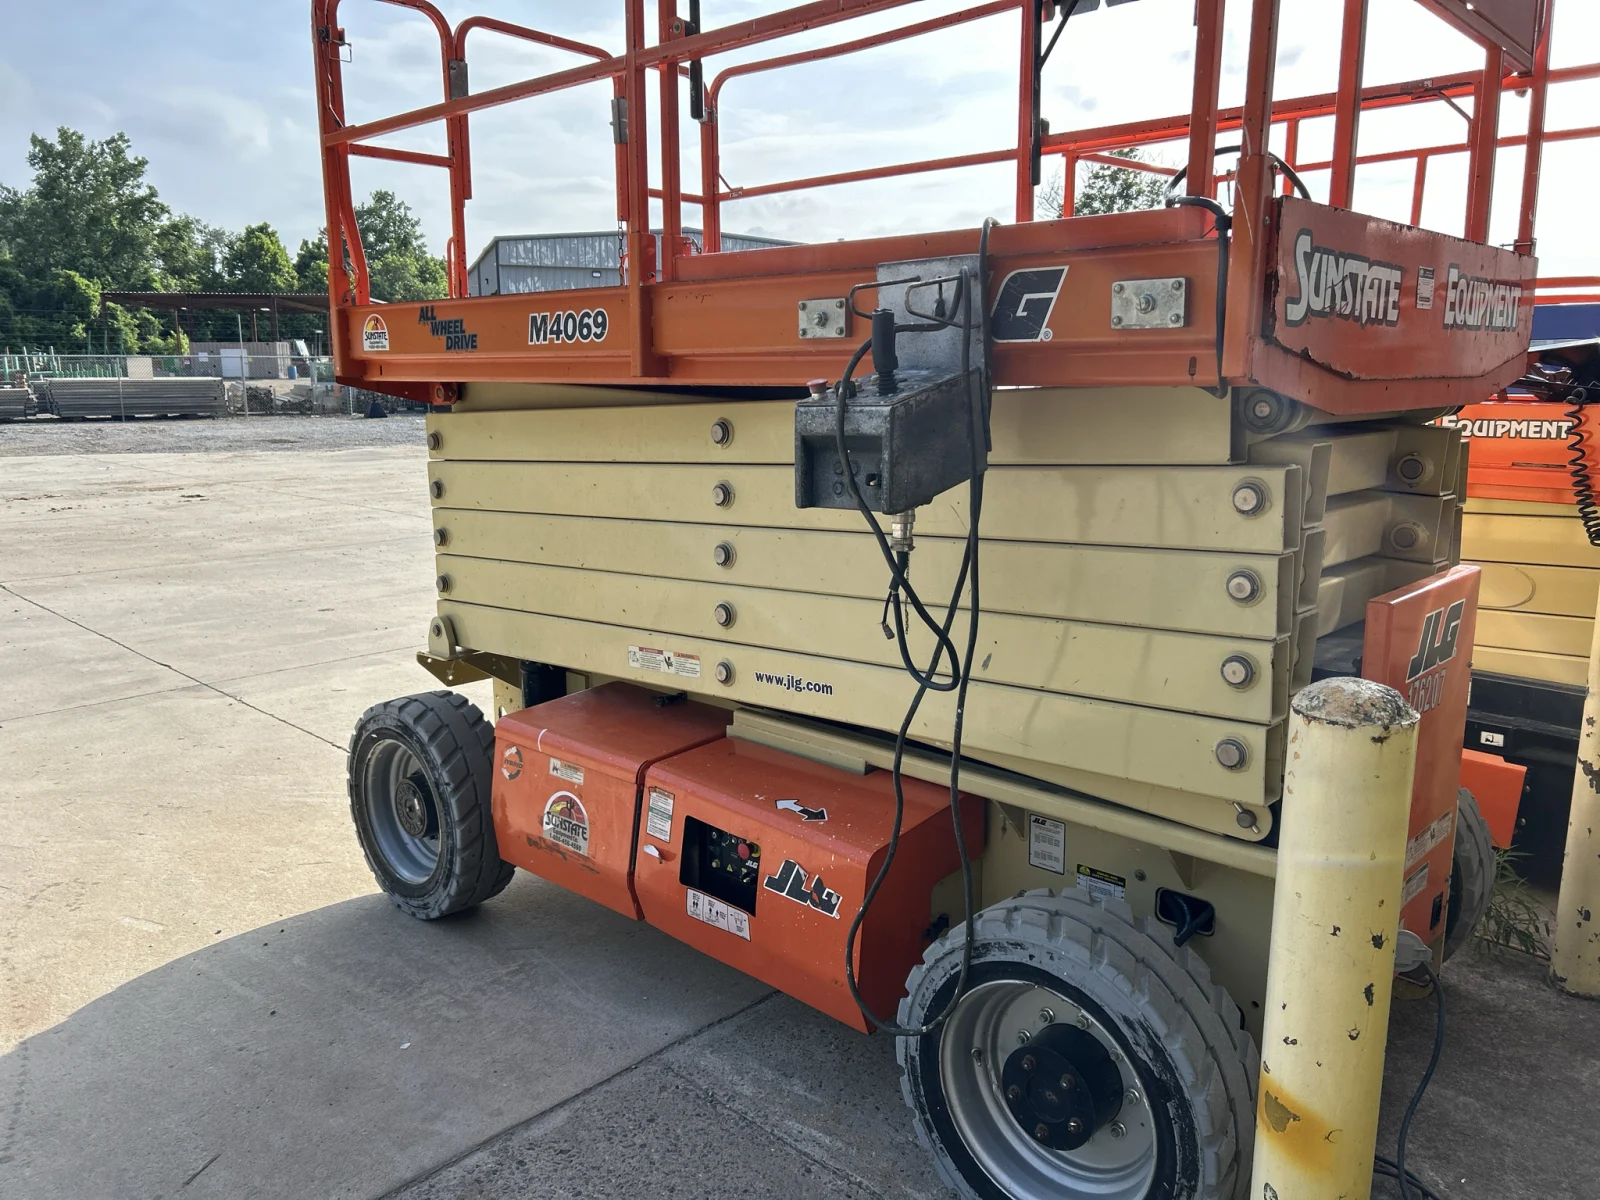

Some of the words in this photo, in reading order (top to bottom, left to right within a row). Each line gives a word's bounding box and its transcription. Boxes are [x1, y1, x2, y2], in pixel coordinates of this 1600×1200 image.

[1285, 228, 1404, 329] SUNSTATE
[1443, 263, 1522, 332] EQUIPMENT
[418, 304, 437, 323] ALL
[430, 318, 466, 336] WHEEL
[528, 308, 609, 345] M4069
[445, 334, 478, 351] DRIVE
[1442, 415, 1574, 440] EQUIPMENT
[1405, 598, 1466, 683] JLG
[754, 671, 834, 696] www.jlg.com
[1408, 668, 1446, 713] 176207
[1032, 817, 1047, 826] JLG
[763, 859, 843, 919] JLG
